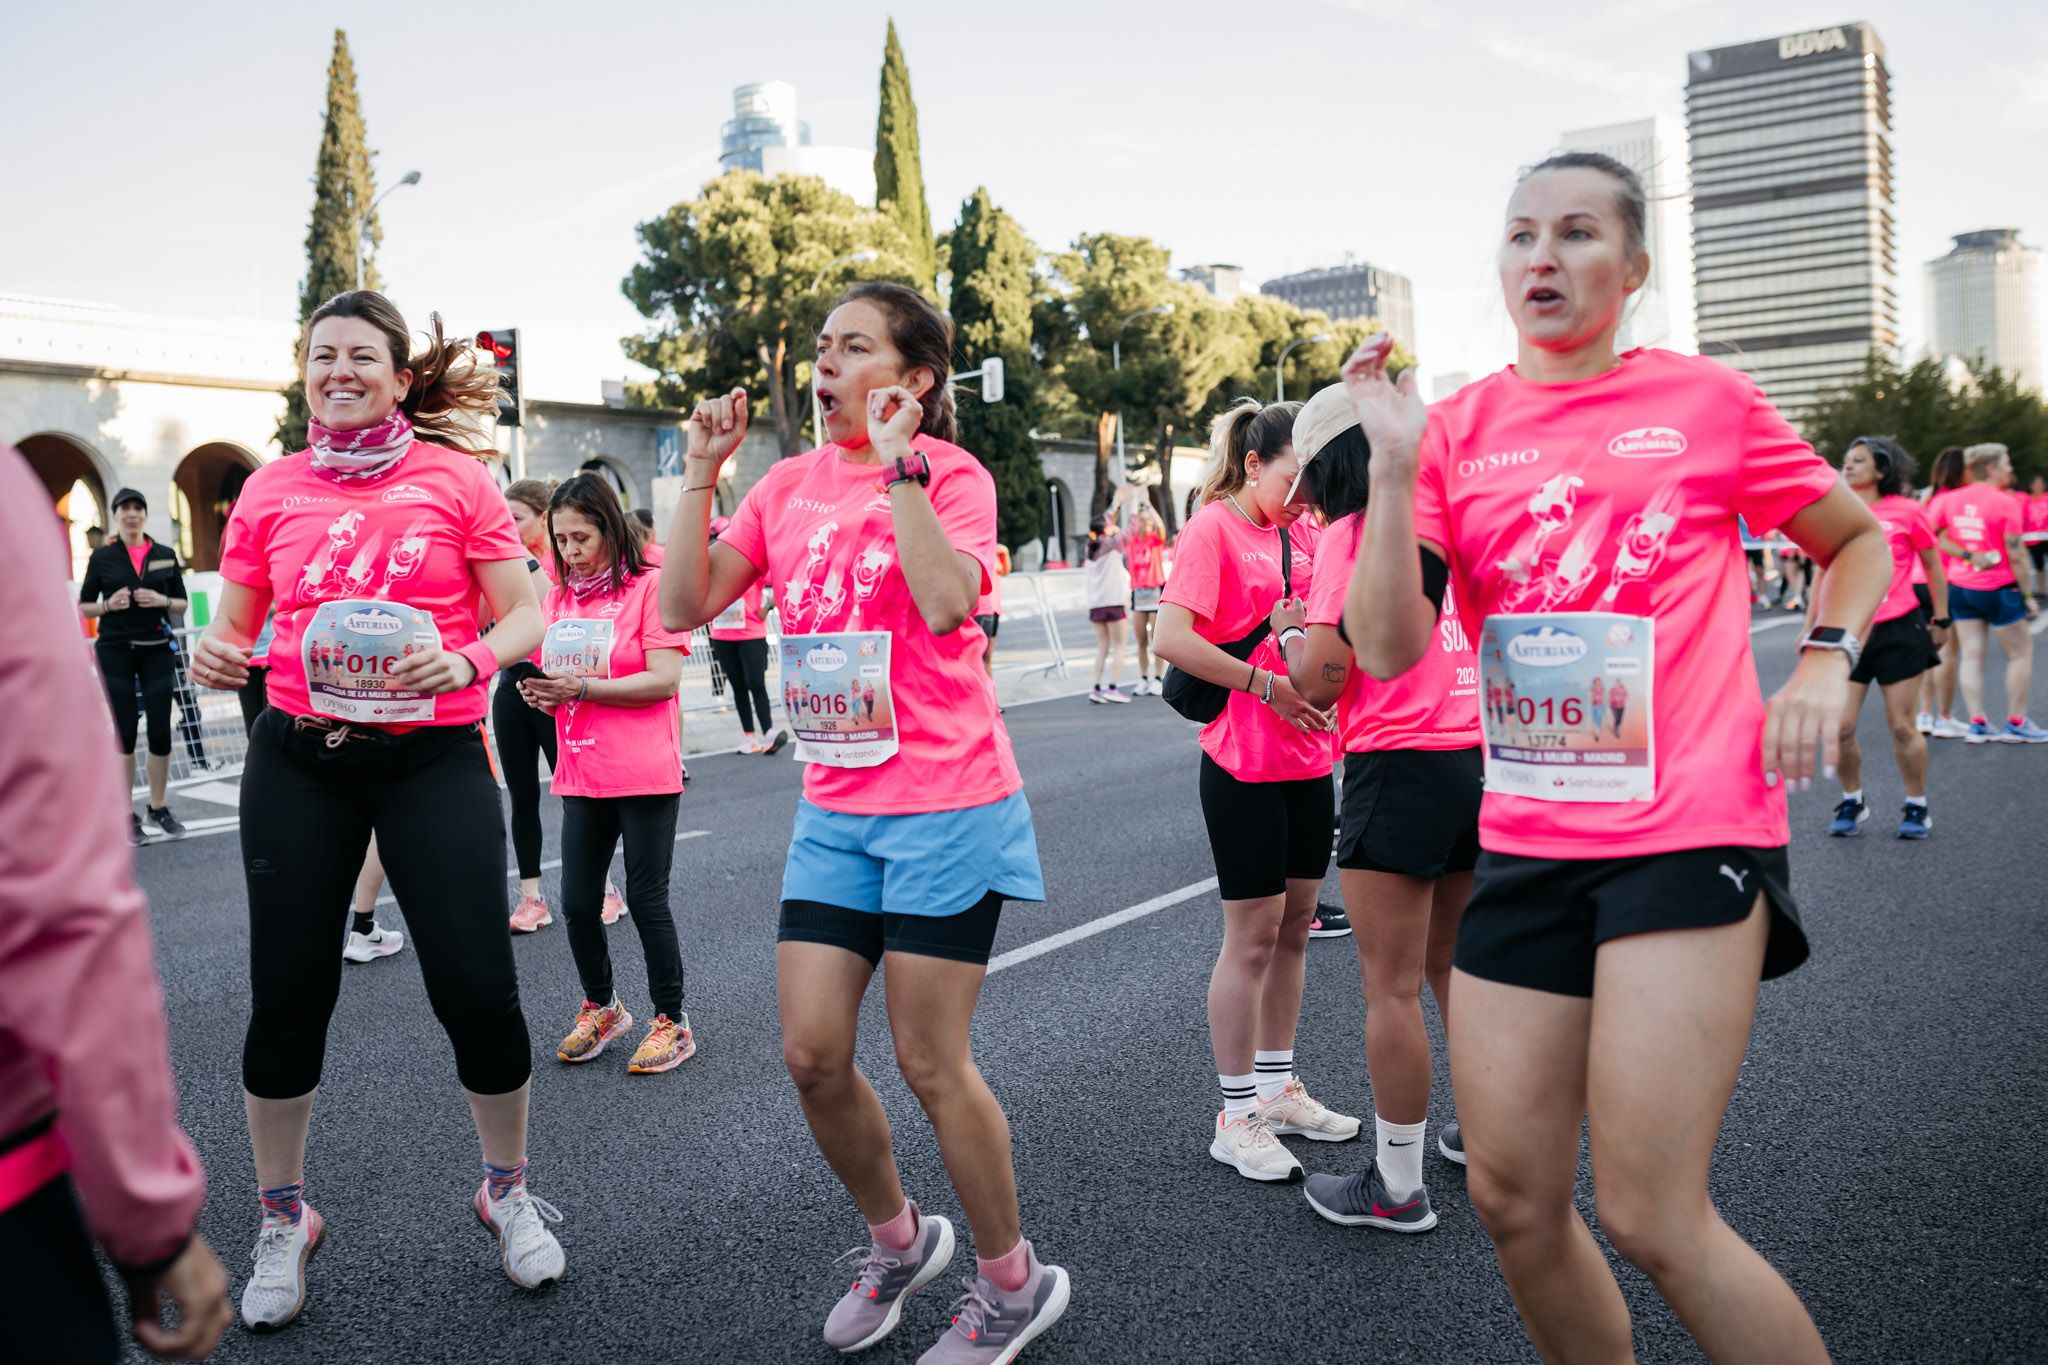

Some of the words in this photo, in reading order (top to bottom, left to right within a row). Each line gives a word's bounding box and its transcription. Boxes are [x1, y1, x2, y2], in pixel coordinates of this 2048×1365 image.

[1458, 448, 1540, 478] OYSHO
[347, 617, 399, 631] ASTURIANA
[1512, 642, 1582, 657] ASTURIANA
[346, 654, 399, 675] 016
[555, 653, 582, 667] 016
[1456, 667, 1479, 685] 202
[355, 680, 385, 689] 18930
[384, 707, 420, 715] Santander
[810, 693, 847, 715] 016
[1517, 697, 1583, 726] 016
